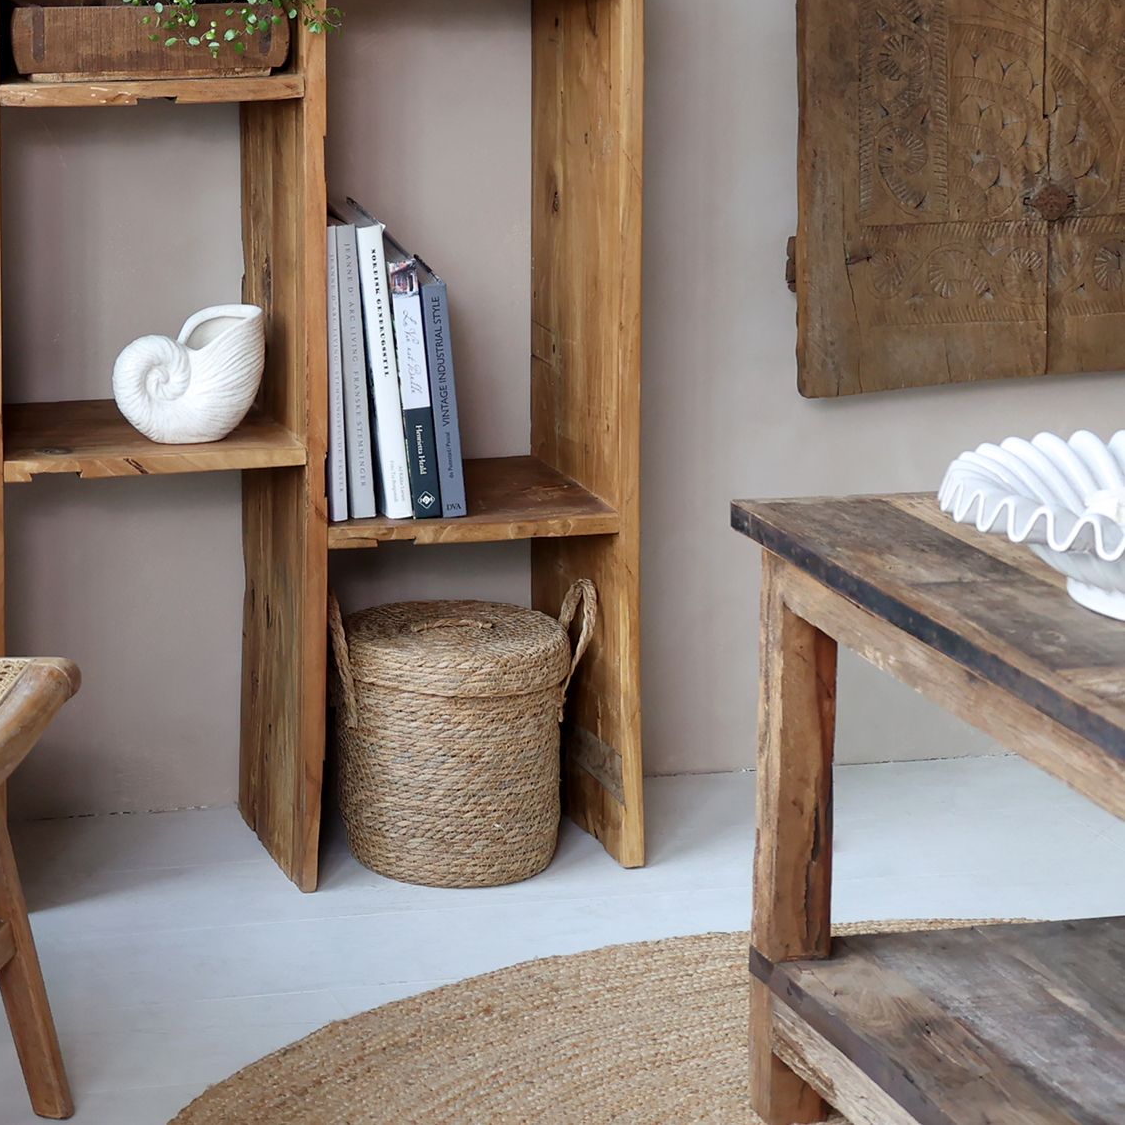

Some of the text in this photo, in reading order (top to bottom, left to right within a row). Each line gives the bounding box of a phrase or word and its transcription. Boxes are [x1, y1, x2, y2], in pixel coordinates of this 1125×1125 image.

[344, 243, 353, 281] JEANNE
[353, 371, 361, 415] FRANSKE
[357, 420, 366, 487] STEMNINGER
[431, 296, 449, 426] VINTAGE INDUSTRIAL STYLE
[415, 425, 427, 475] Henrietta Heald
[447, 503, 461, 511] DVA
